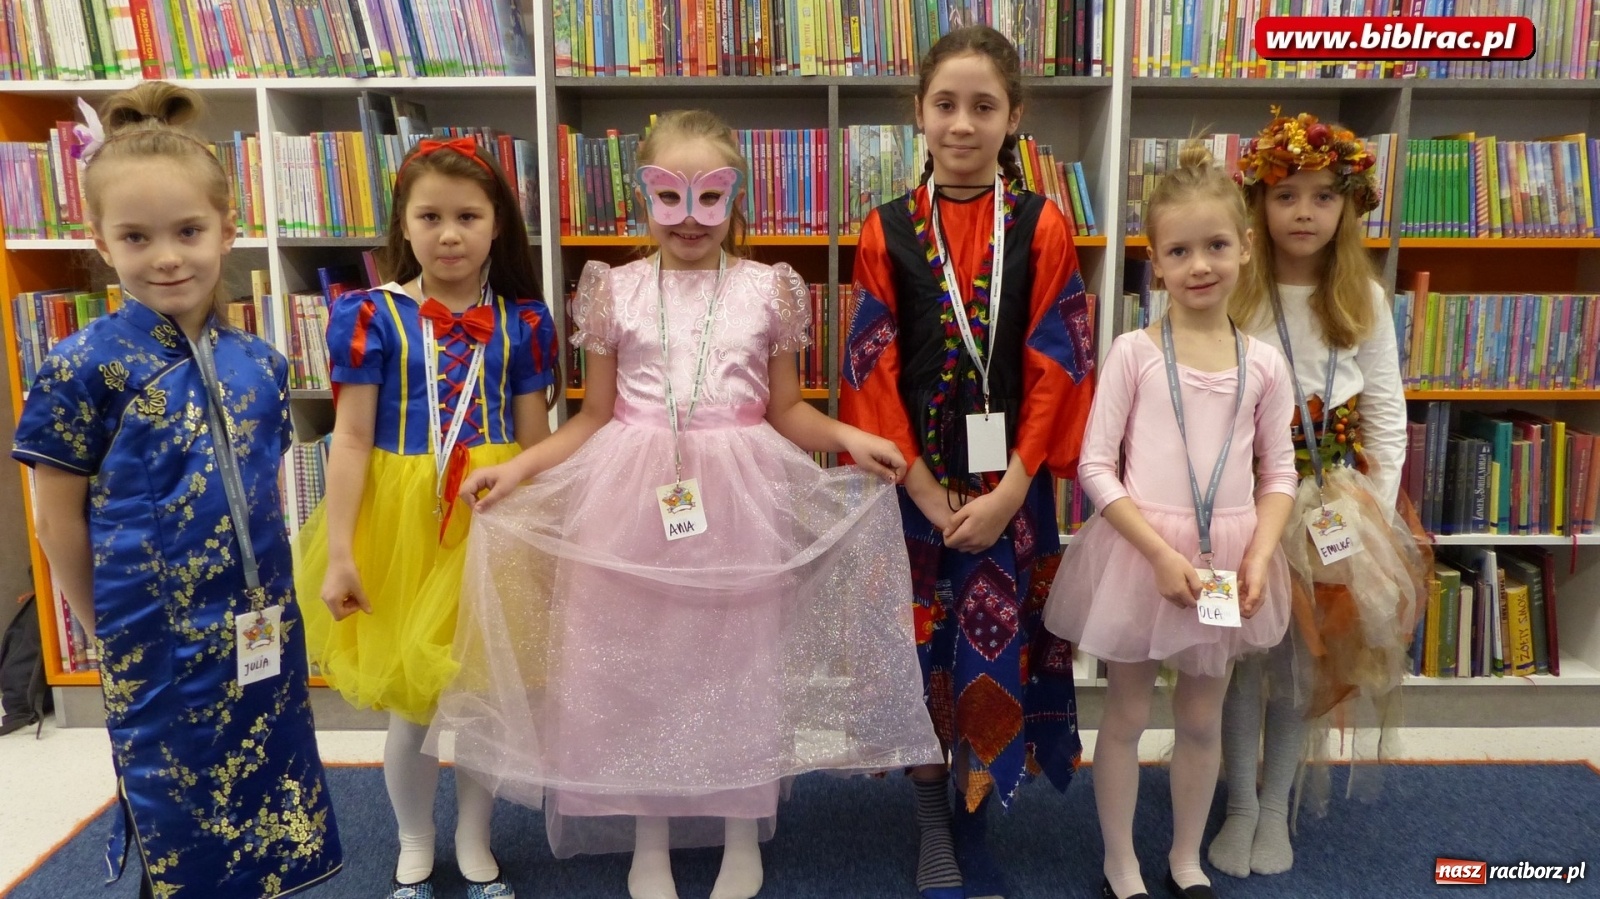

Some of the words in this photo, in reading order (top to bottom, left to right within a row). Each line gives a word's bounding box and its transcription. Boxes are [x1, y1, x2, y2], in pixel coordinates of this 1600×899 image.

[138, 8, 154, 60] PADDINGTON
[669, 520, 695, 537] ANIA
[1320, 537, 1354, 558] EMILKA
[1517, 594, 1529, 624] SMOK
[1515, 629, 1530, 662] ŻÓŁTY
[244, 655, 270, 677] JULIA
